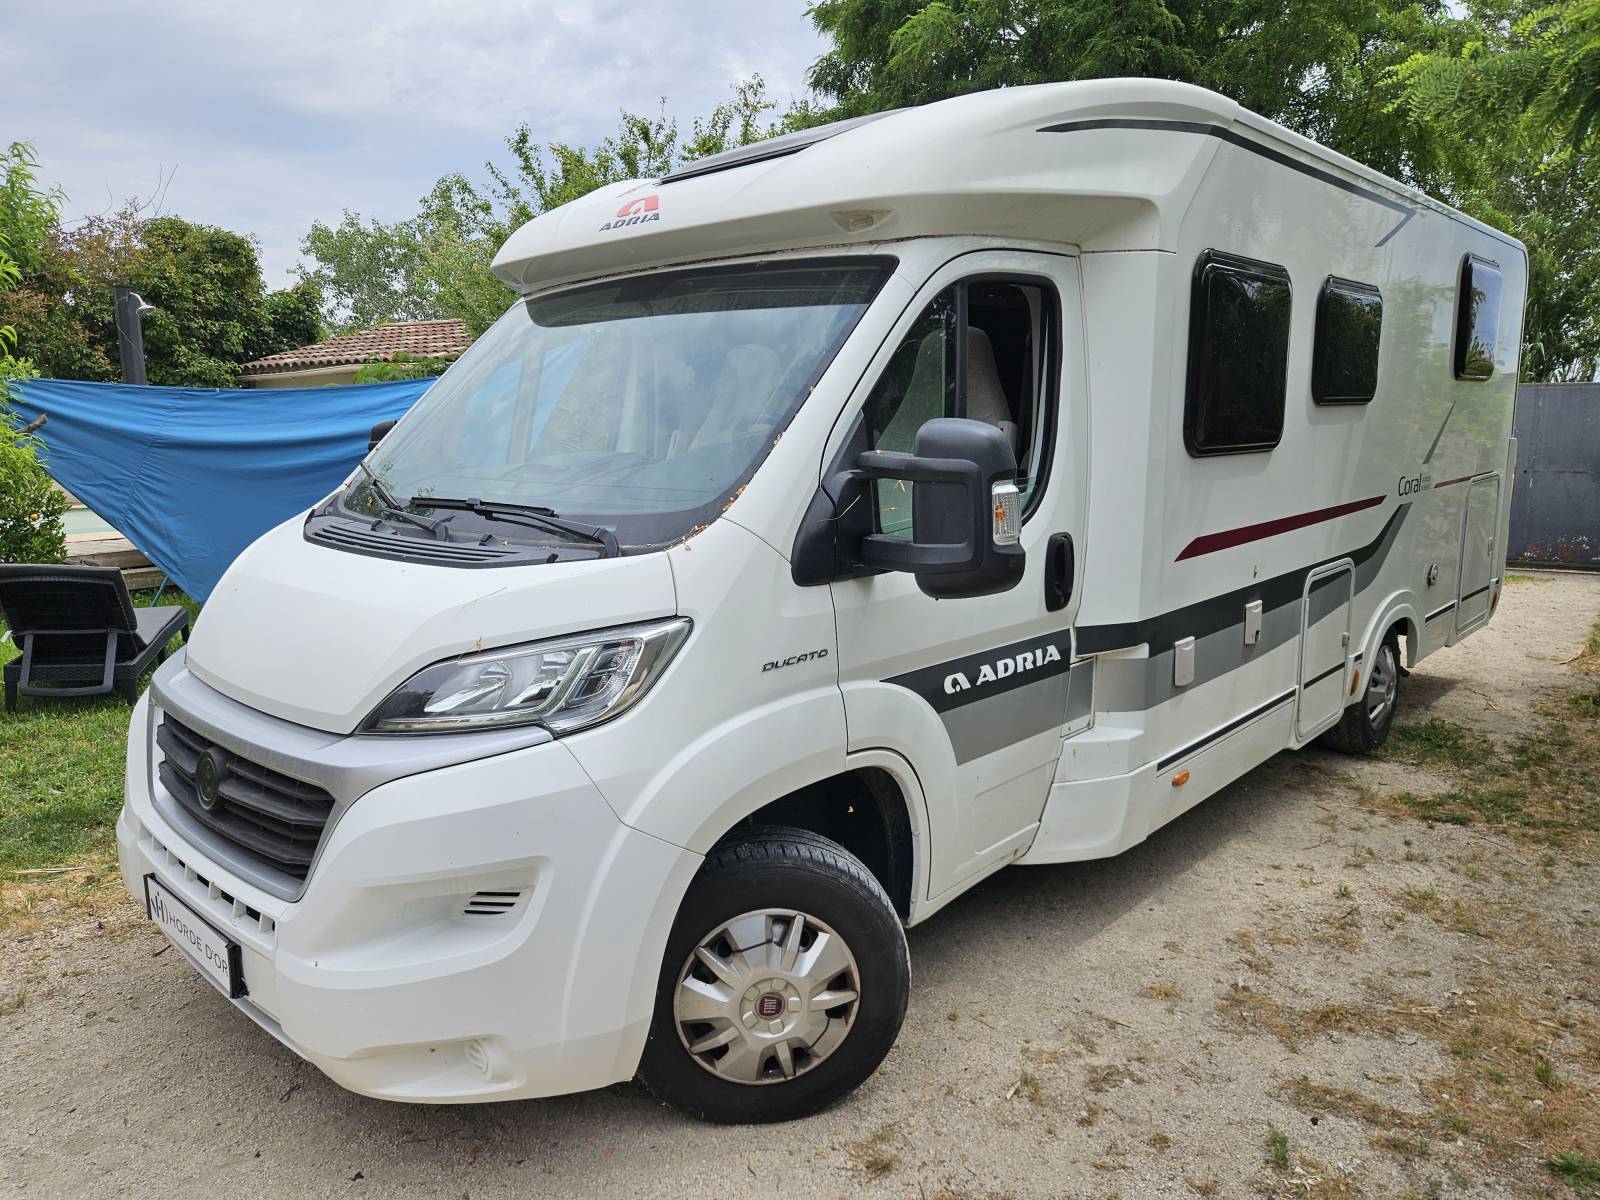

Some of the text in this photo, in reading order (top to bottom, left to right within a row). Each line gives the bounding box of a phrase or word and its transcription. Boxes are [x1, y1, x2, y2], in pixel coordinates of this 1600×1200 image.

[598, 212, 660, 232] ADRIA
[1398, 472, 1422, 496] Coral
[761, 648, 828, 672] DUCATO
[976, 644, 1062, 686] ADRIA
[168, 911, 229, 977] HORDE D'OR
